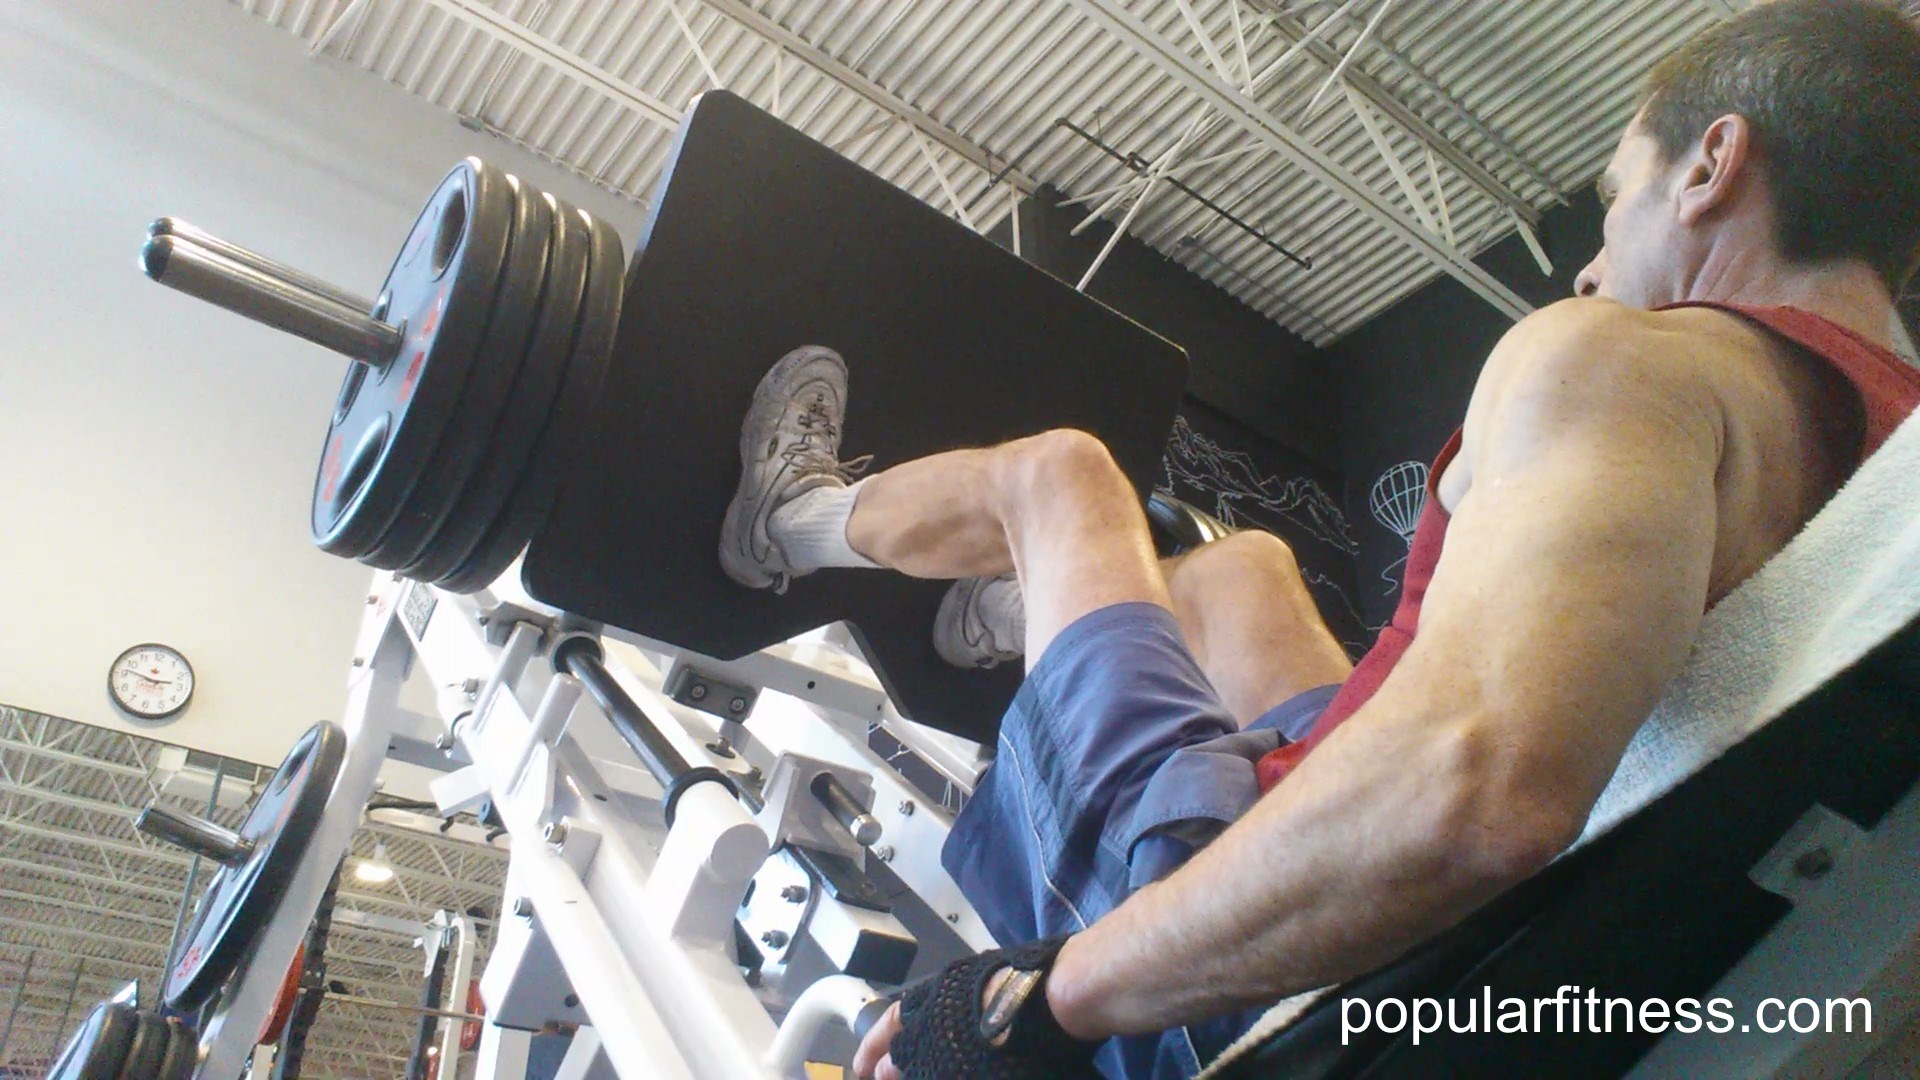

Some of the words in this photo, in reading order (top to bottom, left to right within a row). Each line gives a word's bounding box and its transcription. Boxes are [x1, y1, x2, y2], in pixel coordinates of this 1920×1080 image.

[155, 653, 164, 662] 12
[127, 660, 138, 668] 10
[121, 670, 128, 678] 9
[177, 672, 184, 680] 2
[121, 683, 128, 692] 8
[176, 683, 183, 691] 3
[130, 694, 137, 702] 7
[142, 700, 149, 708] 6
[158, 700, 164, 709] 5
